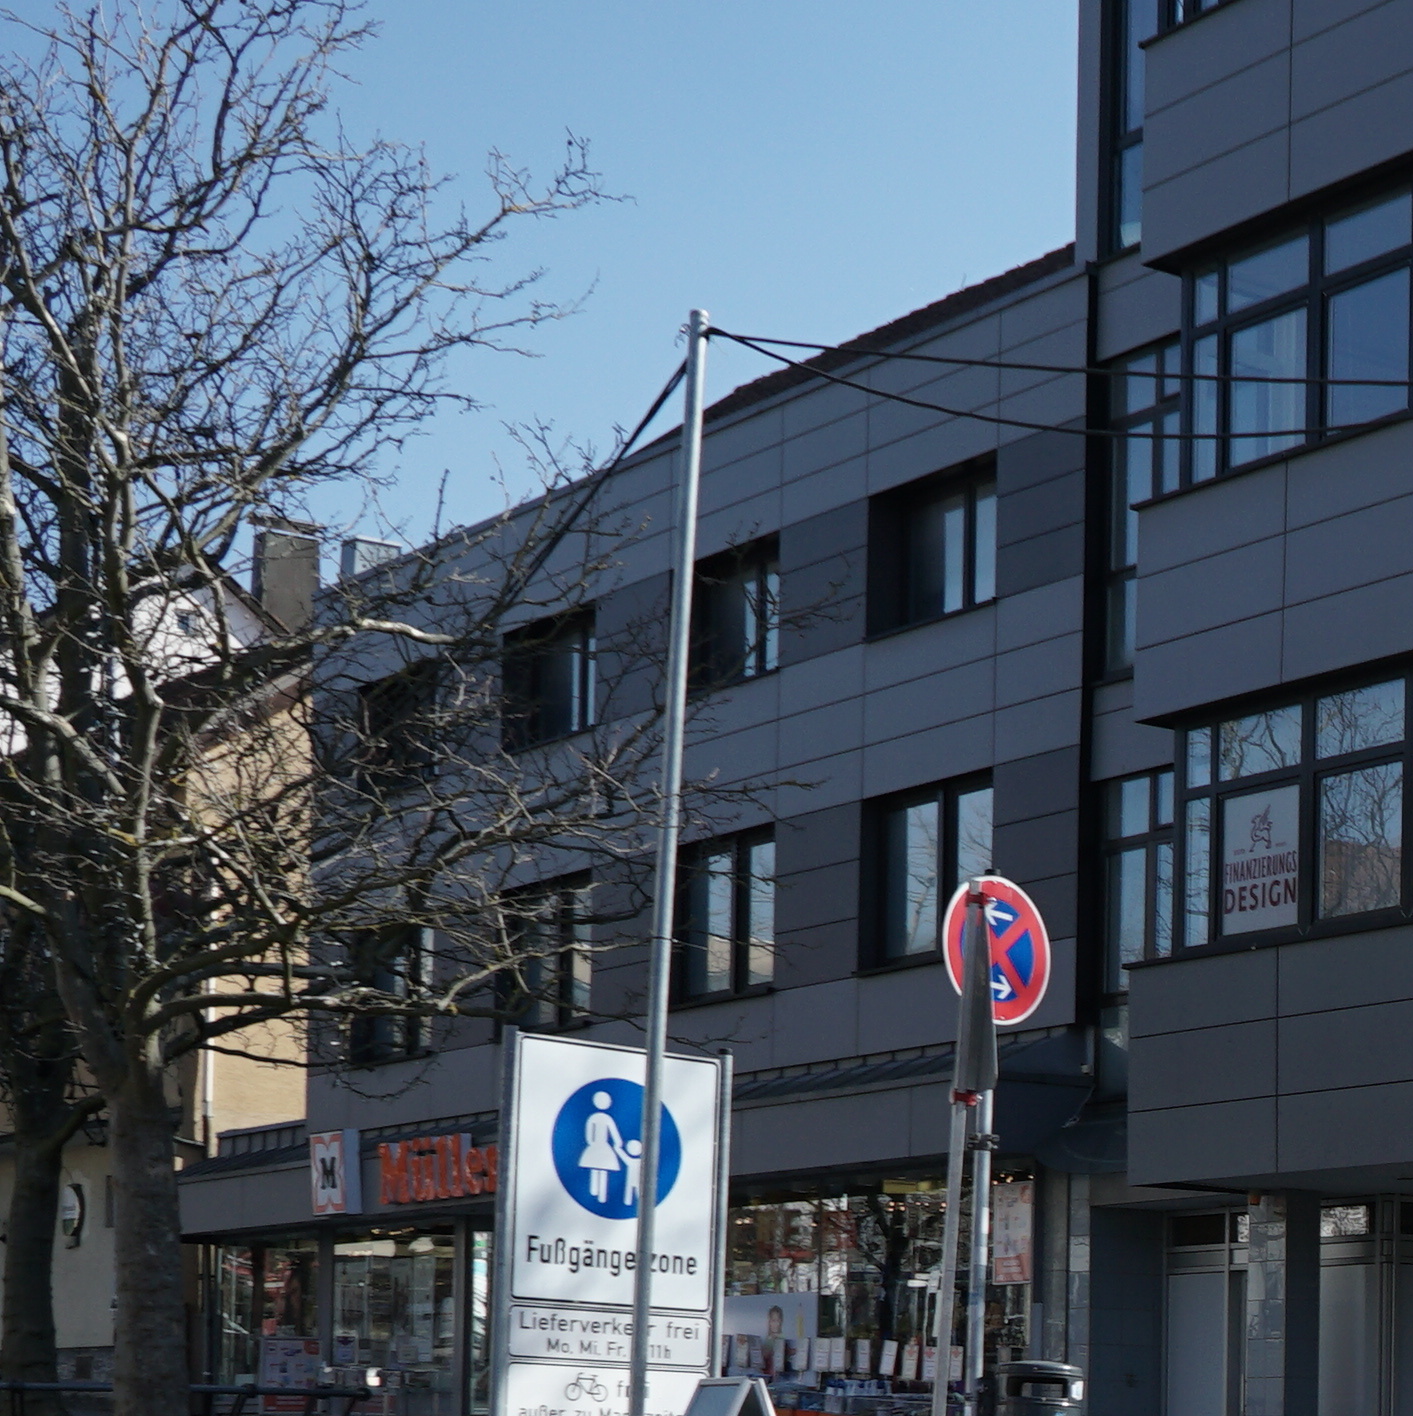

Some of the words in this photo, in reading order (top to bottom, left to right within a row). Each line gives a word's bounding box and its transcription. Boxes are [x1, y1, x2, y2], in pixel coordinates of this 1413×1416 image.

[1225, 850, 1297, 884] FINANZIERUNGS
[1224, 877, 1297, 914] DESIGN
[320, 1156, 337, 1190] M
[526, 1235, 698, 1277] Fußgängezone
[519, 1311, 657, 1337] Lieferverker
[666, 1321, 700, 1340] frei
[546, 1338, 574, 1354] Mo.
[607, 1341, 626, 1358] Fr.
[617, 1380, 650, 1399] fri
